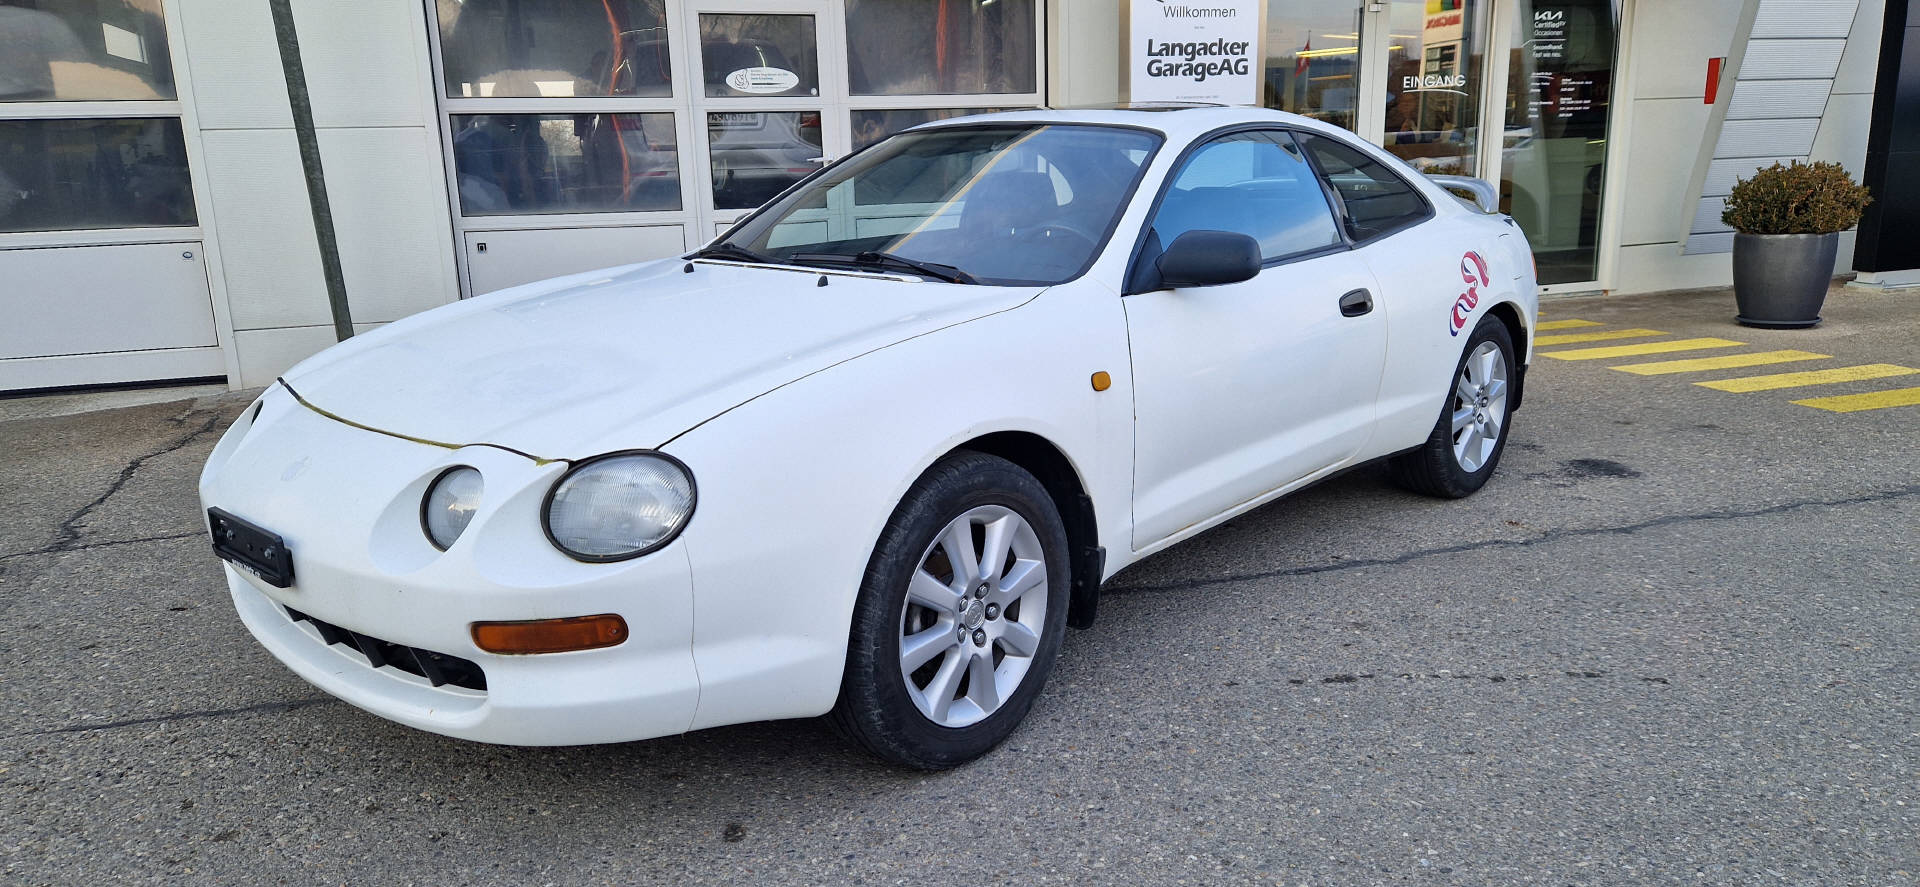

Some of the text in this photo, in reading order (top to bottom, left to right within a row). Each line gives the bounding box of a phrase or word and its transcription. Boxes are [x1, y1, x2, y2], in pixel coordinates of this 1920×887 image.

[1163, 5, 1236, 18] Willkommen
[1534, 10, 1562, 20] KIA
[1147, 38, 1249, 61] Langacker
[1147, 58, 1249, 82] GarageAG
[1403, 75, 1466, 88] EINGANG
